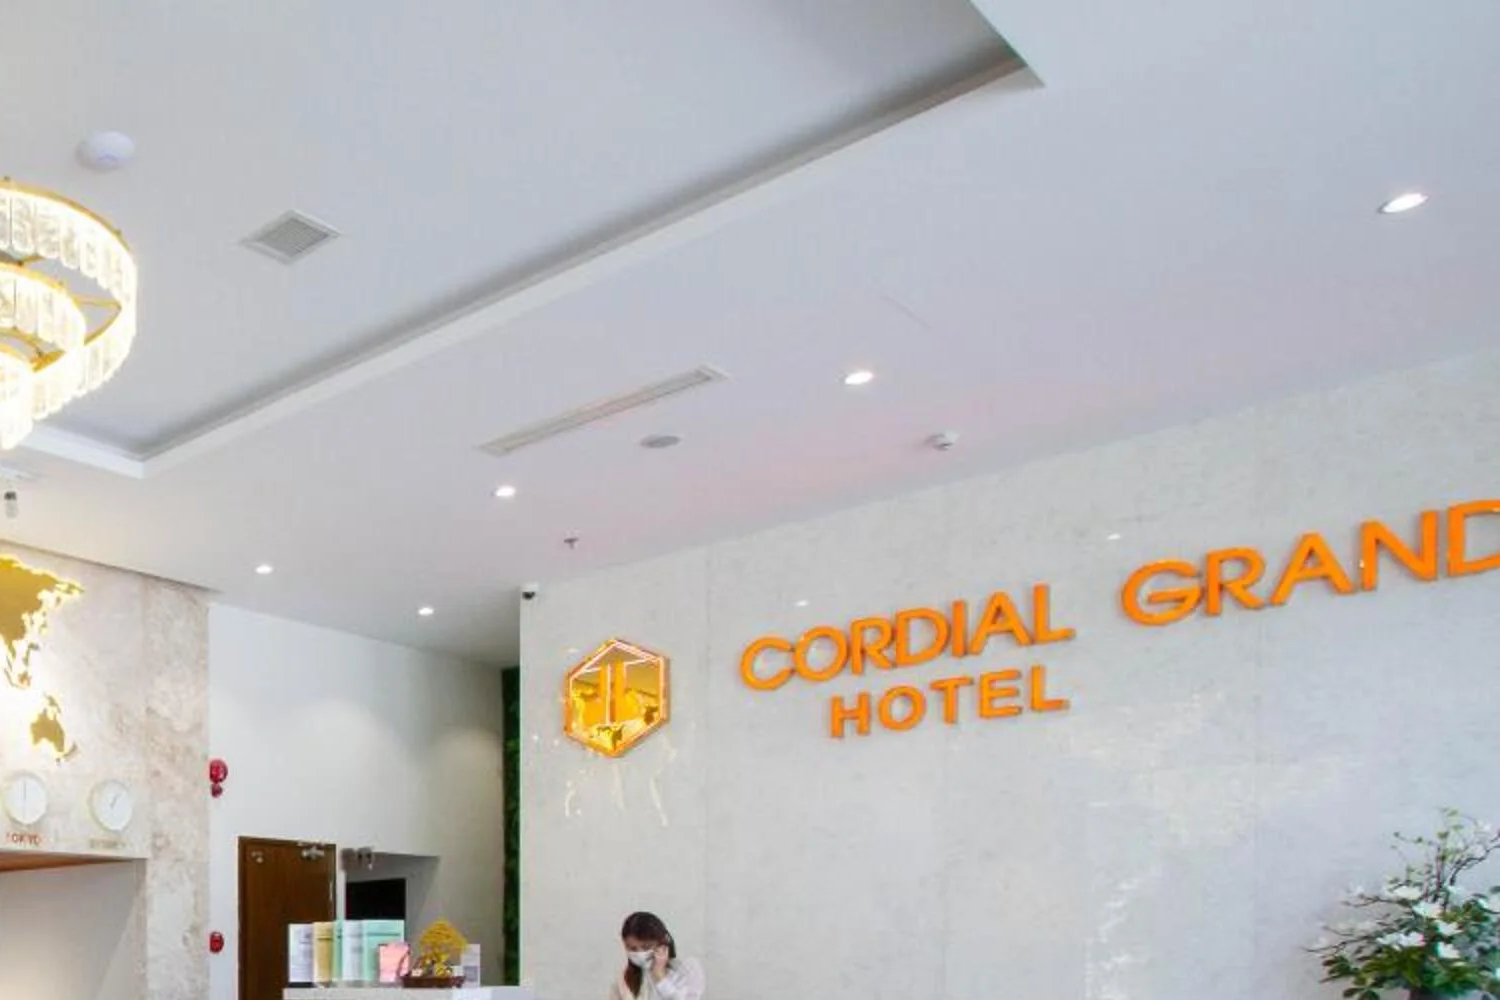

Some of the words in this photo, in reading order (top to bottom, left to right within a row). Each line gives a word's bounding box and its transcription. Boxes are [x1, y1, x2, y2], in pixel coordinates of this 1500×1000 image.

[739, 584, 1075, 691] CORDIAL
[1121, 498, 1500, 627] GRAND
[829, 665, 1069, 738] HOTEL
